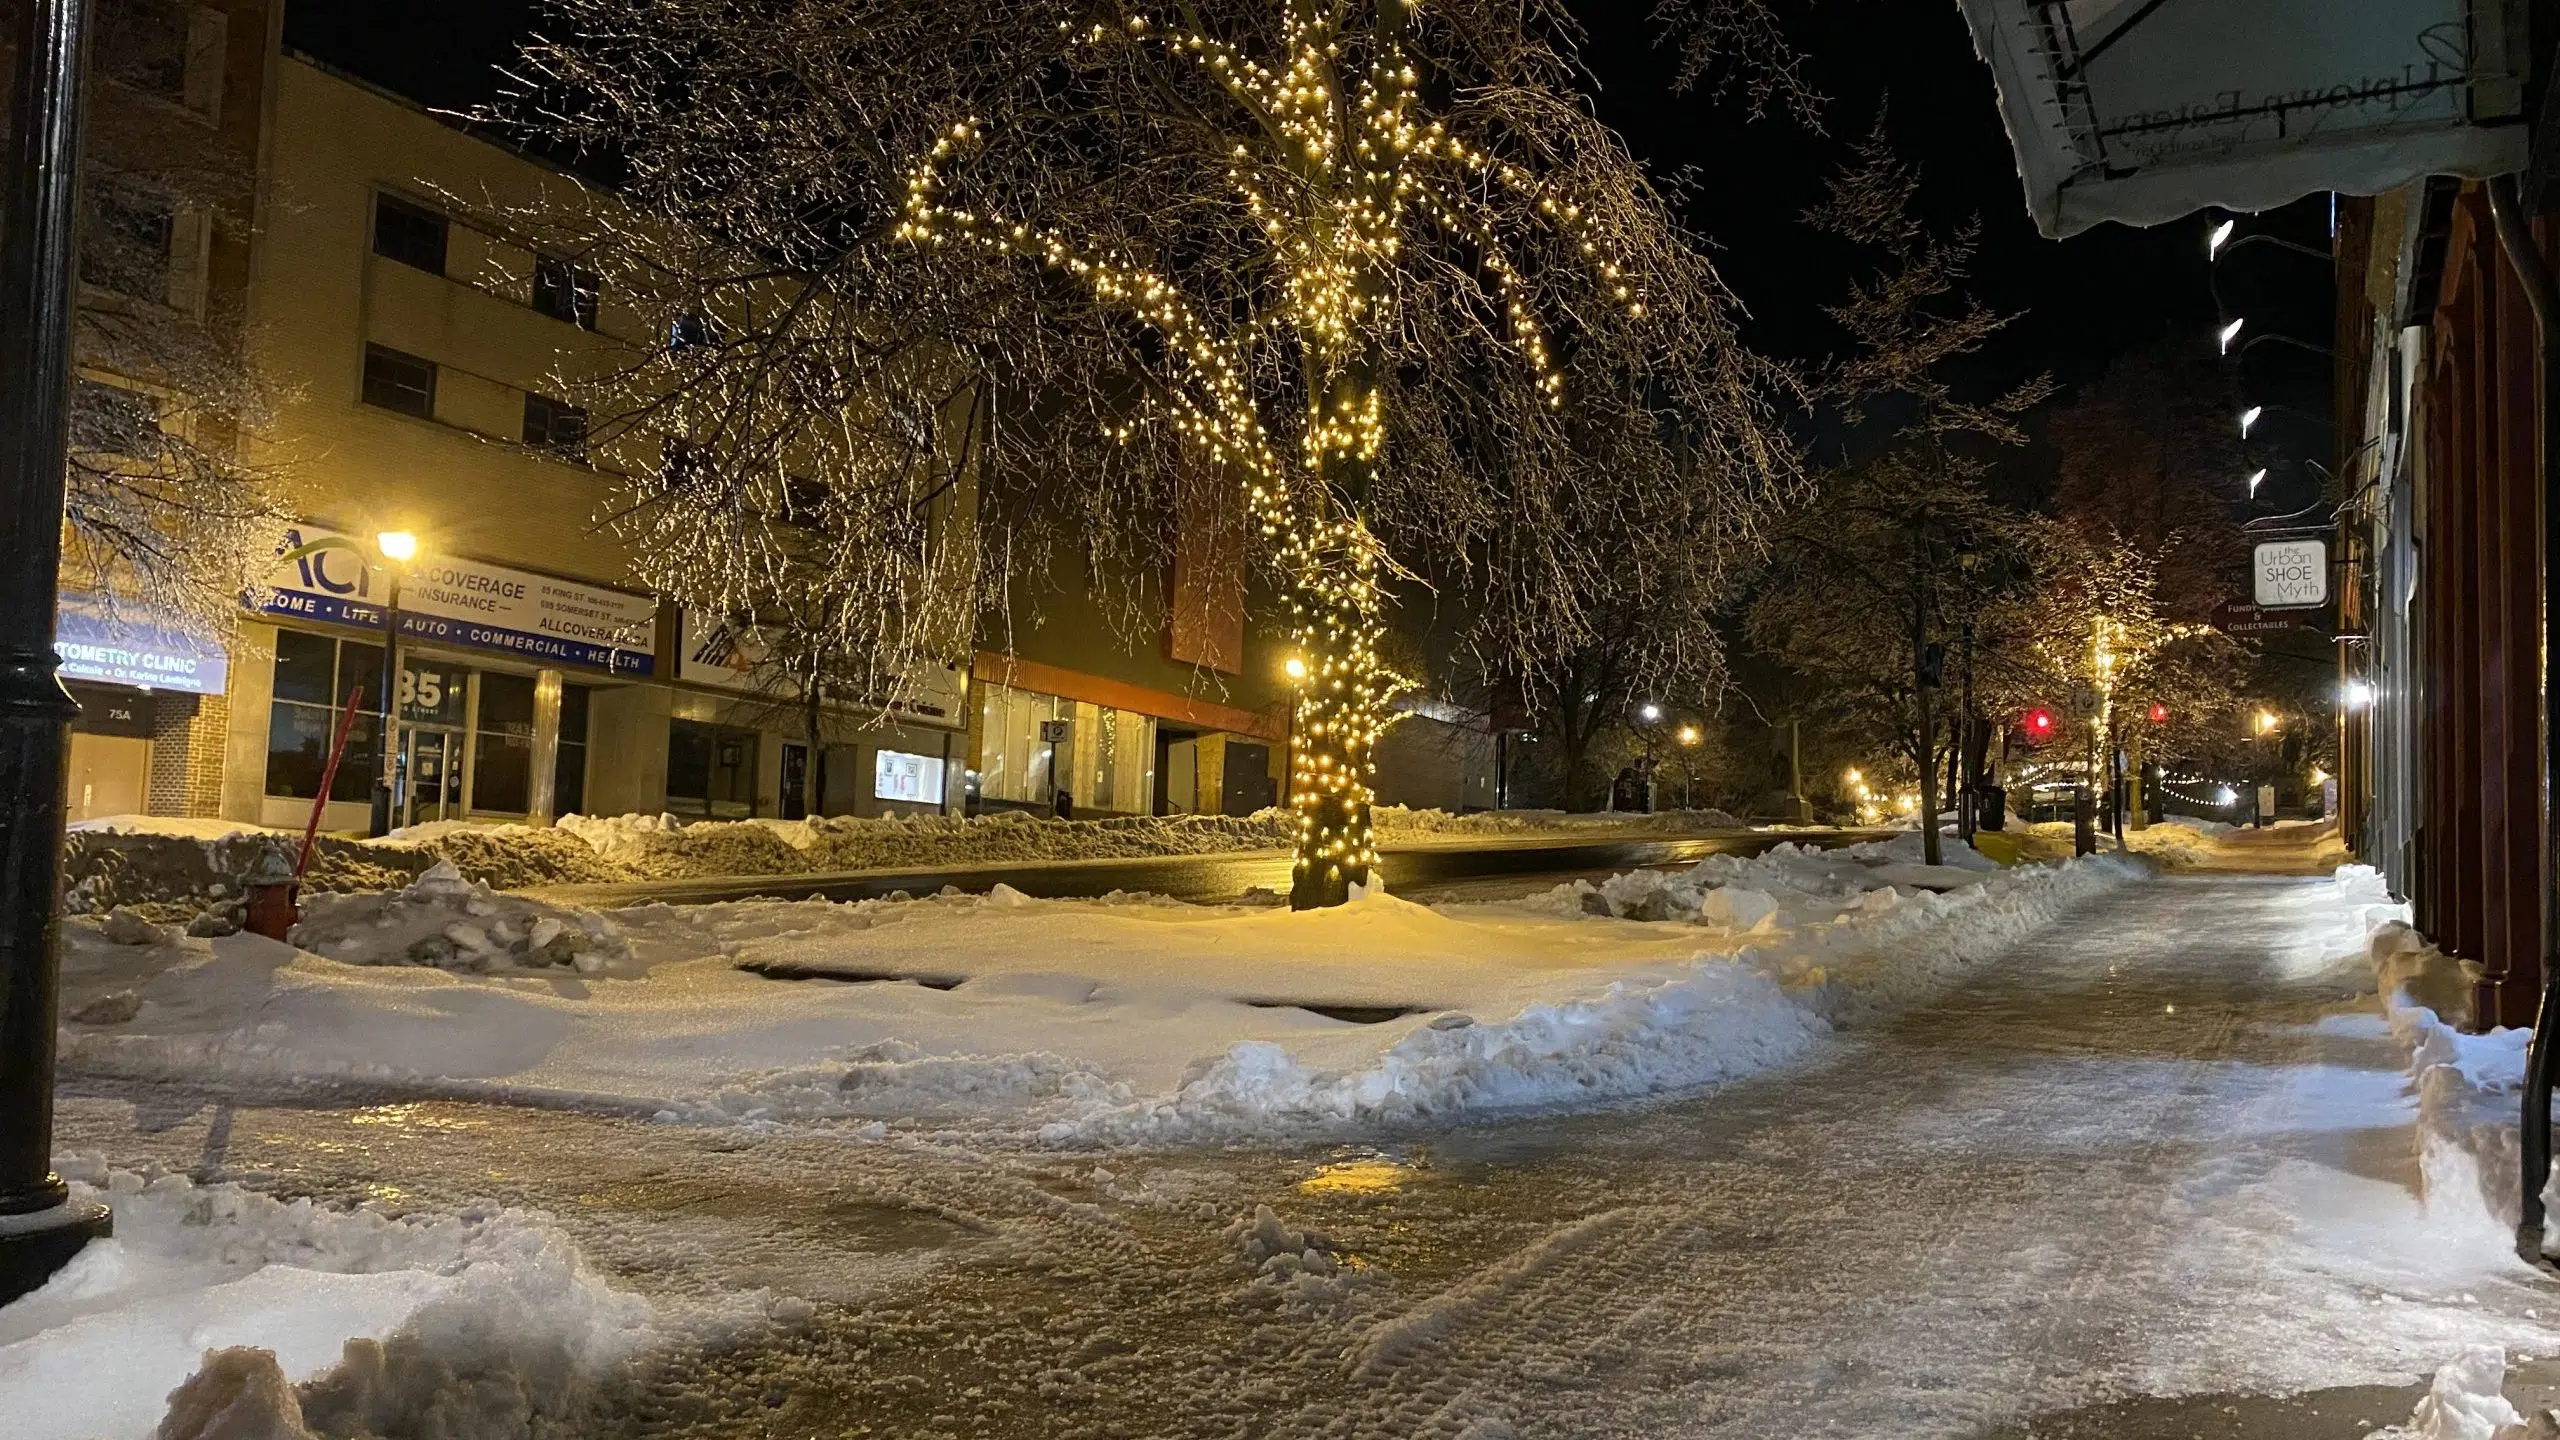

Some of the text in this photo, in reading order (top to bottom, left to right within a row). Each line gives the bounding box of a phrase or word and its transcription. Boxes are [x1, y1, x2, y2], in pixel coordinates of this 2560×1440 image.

[2261, 549, 2312, 567] Urban
[2284, 546, 2300, 554] the
[2265, 565, 2312, 582] SHOE
[430, 568, 526, 600] COVERAGE
[2277, 581, 2319, 599] Myth
[418, 586, 497, 613] INSURANCE
[341, 605, 380, 625] LIFE
[403, 618, 448, 636] AUTO
[470, 629, 567, 657] COMMERCIAL
[587, 650, 640, 669] HEALTH
[142, 654, 197, 674] CLINIC
[108, 708, 131, 720] 75A
